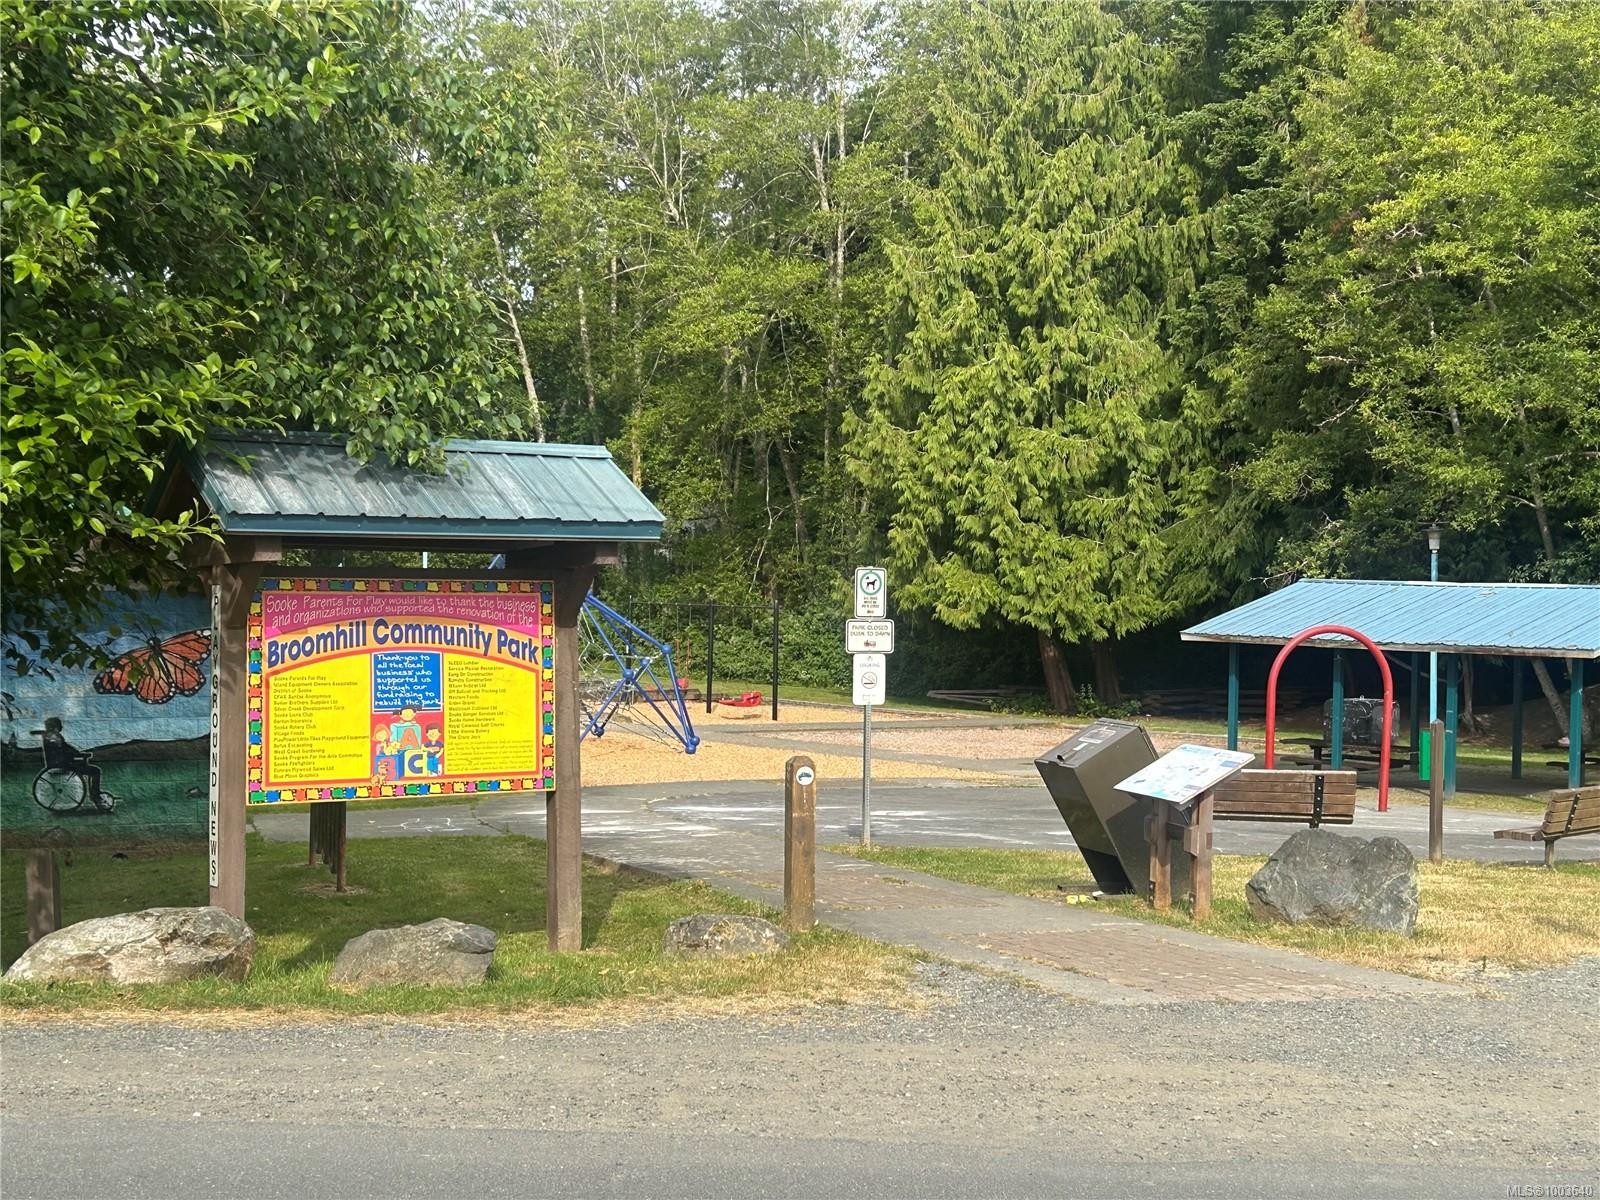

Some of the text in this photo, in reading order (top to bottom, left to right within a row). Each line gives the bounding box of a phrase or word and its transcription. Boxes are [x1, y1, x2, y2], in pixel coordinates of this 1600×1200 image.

[266, 594, 297, 613] Sooke
[303, 596, 343, 610] Parents
[346, 596, 362, 606] For
[366, 596, 386, 606] Play
[388, 596, 416, 605] would
[418, 596, 433, 606] like
[450, 598, 477, 606] thank
[478, 598, 494, 608] the
[496, 597, 536, 613] business
[272, 604, 534, 630] and organizations who supported the renovation of the
[268, 618, 539, 666] Broomhill Community Park
[377, 676, 418, 686] supported
[378, 684, 410, 694] through
[408, 754, 424, 774] C
